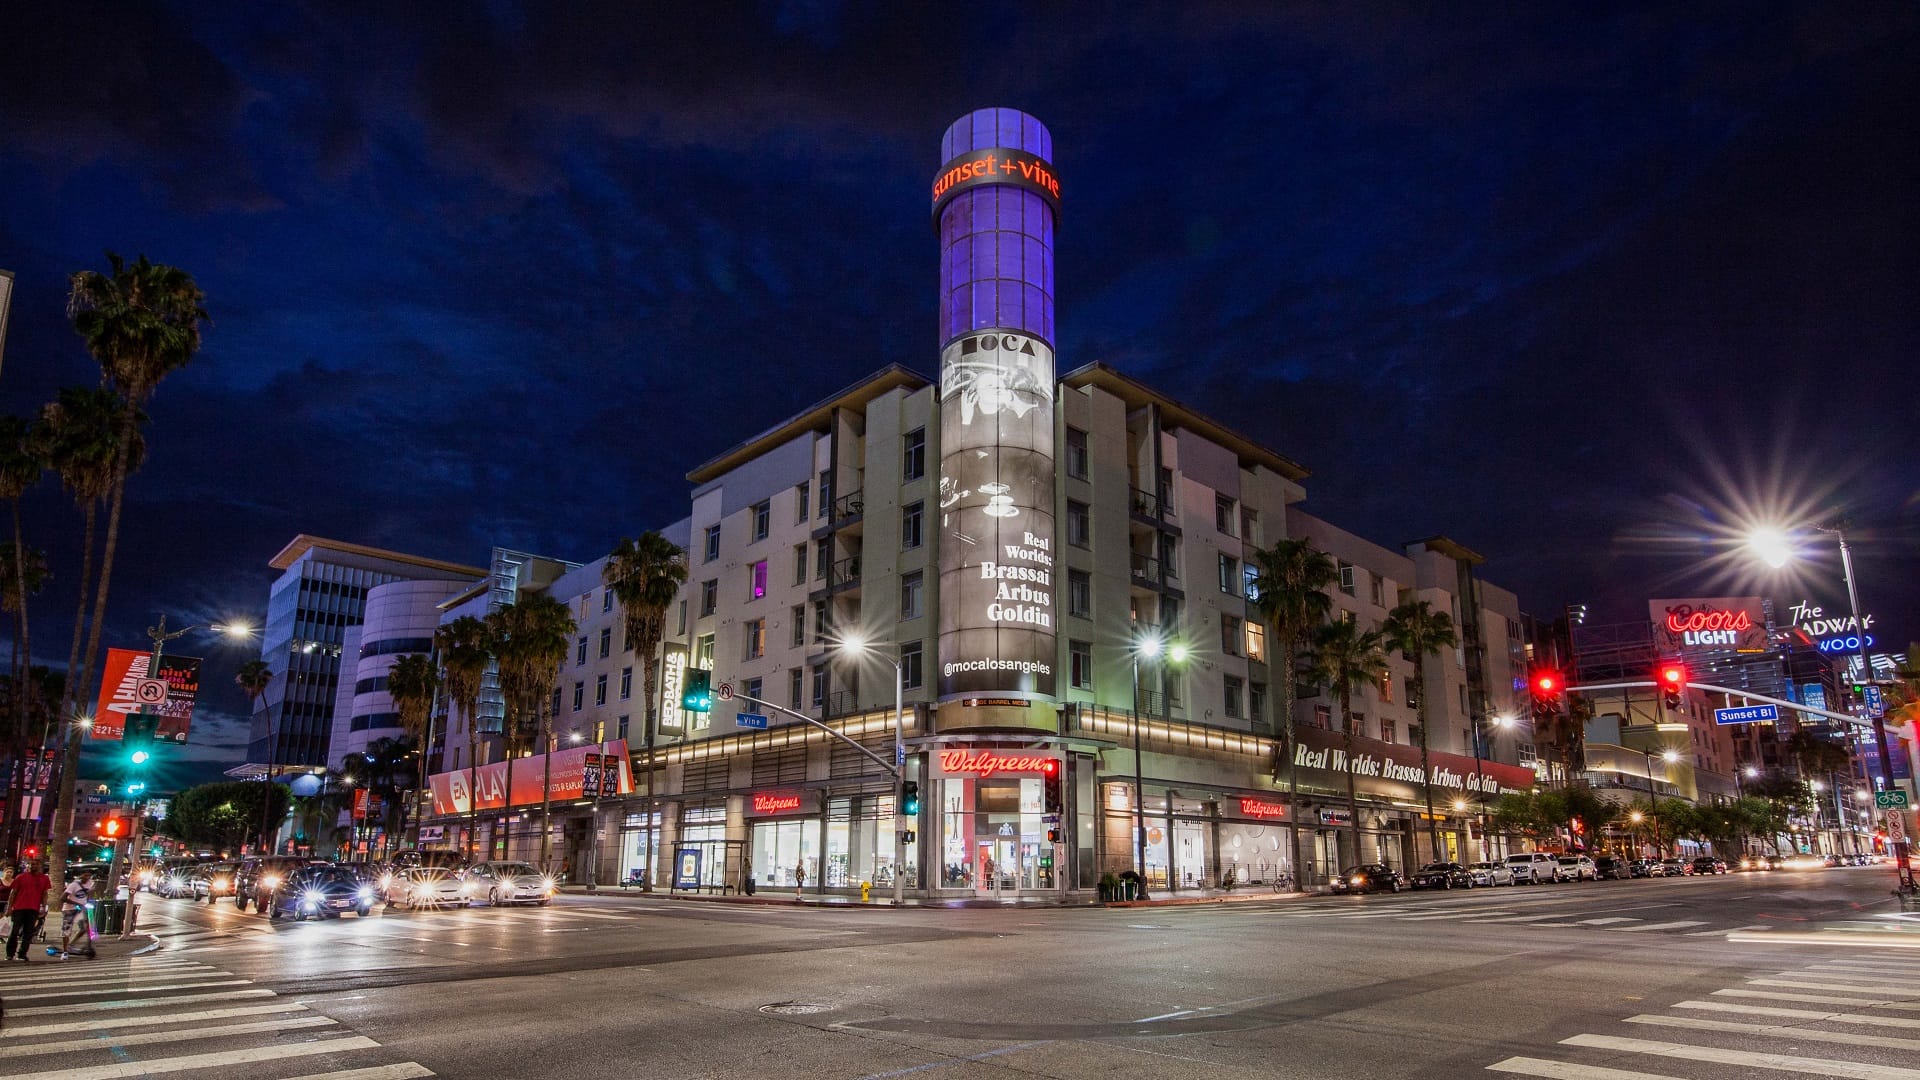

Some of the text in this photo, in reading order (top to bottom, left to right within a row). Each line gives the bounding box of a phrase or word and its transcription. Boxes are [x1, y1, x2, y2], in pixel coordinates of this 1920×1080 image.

[933, 154, 997, 202] sunset
[1017, 160, 1060, 198] vine
[1023, 531, 1049, 550] Real
[995, 582, 1050, 606] Arbus
[987, 603, 1050, 627] Goldin
[1666, 606, 1751, 632] Coors
[1789, 600, 1822, 626] The
[1684, 630, 1737, 645] LIGHT
[944, 657, 1050, 677] @mocalosangeles
[664, 664, 677, 699] BATH
[743, 716, 761, 726] Vine
[1720, 708, 1772, 720] Sunset Bl
[1294, 743, 1329, 769] Real
[1429, 765, 1464, 791] Arbus,
[453, 781, 467, 800] EA
[754, 795, 799, 814] Walgreens
[1242, 799, 1284, 818] Walgreens
